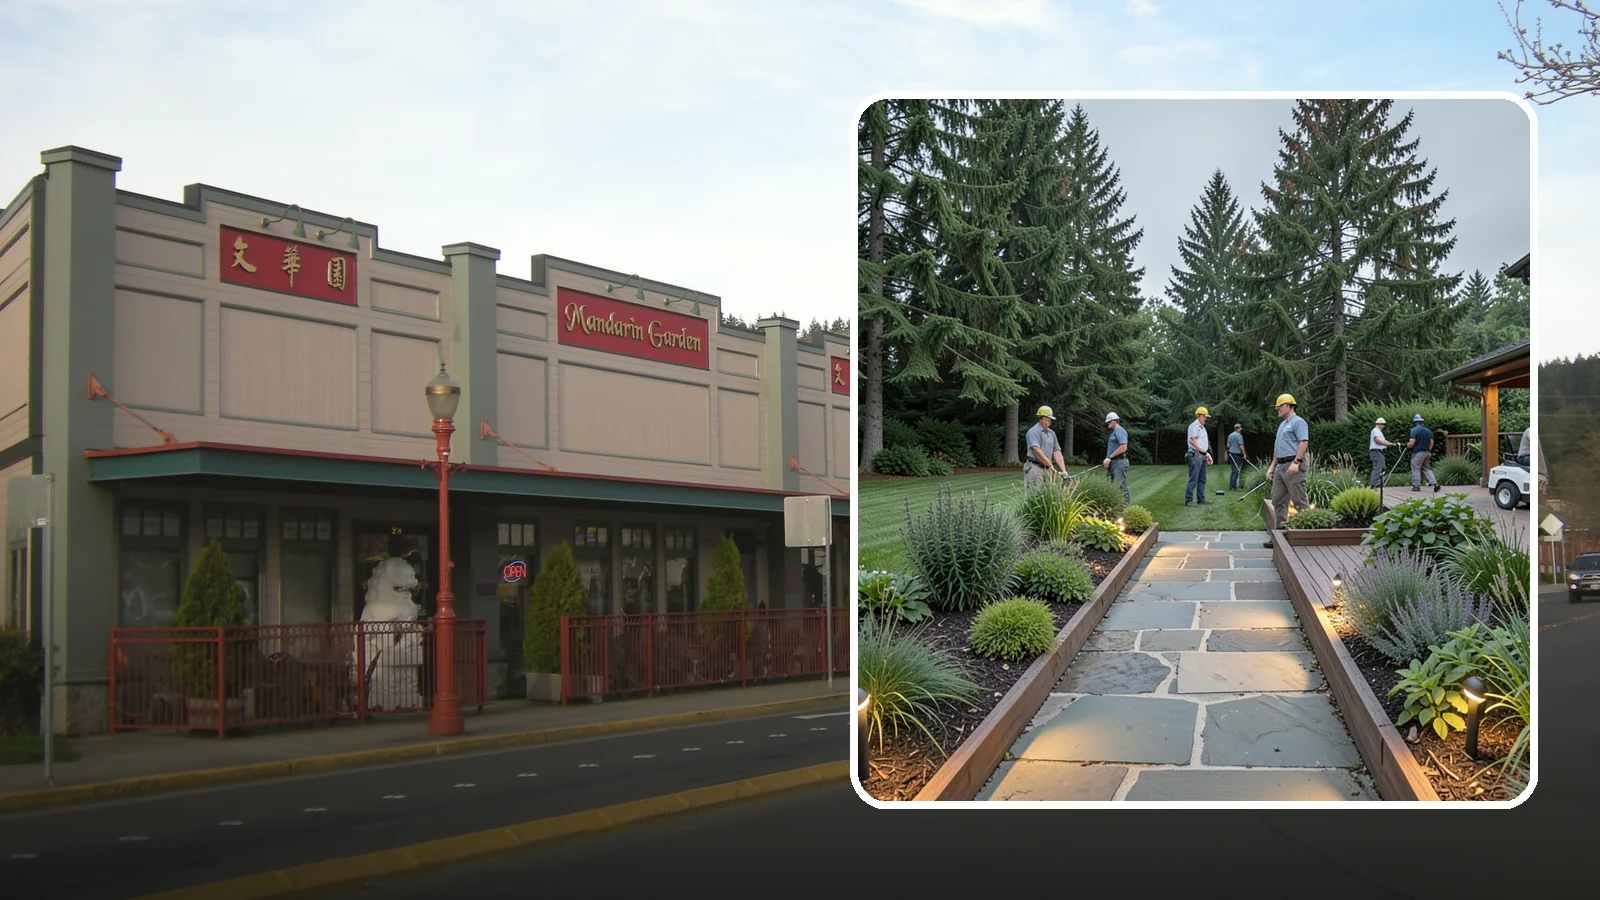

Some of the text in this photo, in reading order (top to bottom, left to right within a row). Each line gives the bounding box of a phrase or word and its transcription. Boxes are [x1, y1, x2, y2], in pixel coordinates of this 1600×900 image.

[564, 302, 701, 352] Mandarin Garden
[503, 565, 527, 578] OPEN
